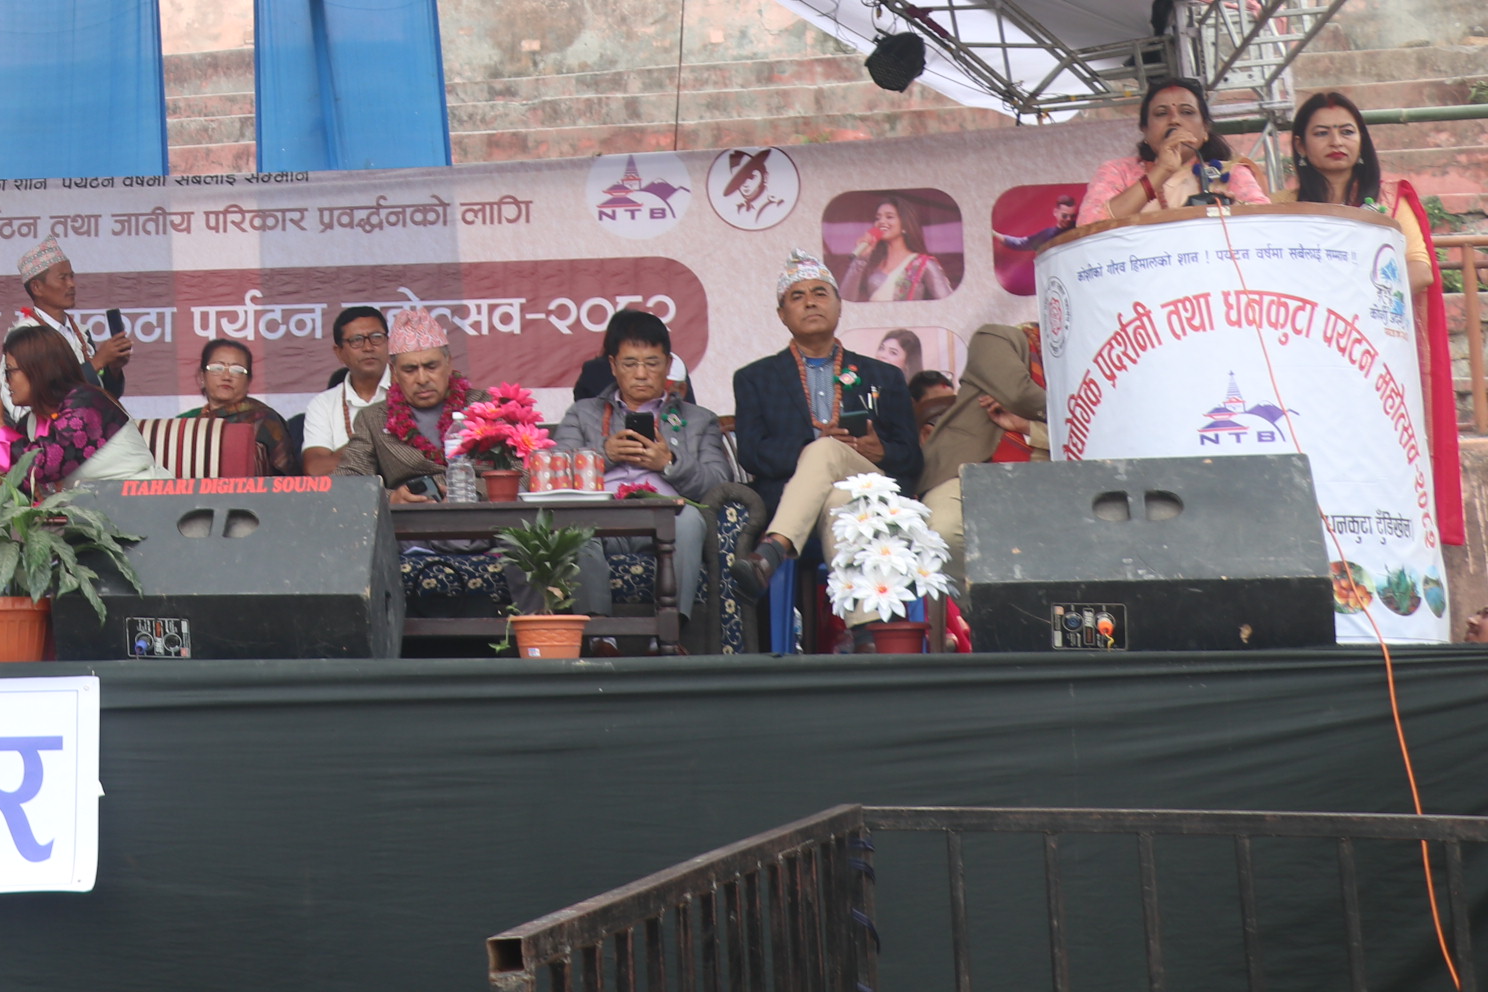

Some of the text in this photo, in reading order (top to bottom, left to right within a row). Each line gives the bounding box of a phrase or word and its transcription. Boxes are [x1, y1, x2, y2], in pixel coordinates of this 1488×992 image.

[49, 214, 102, 238] तथा
[111, 206, 194, 237] जातीय
[203, 204, 308, 234] परिकार
[459, 194, 533, 225] लागि
[598, 208, 667, 221] NTB
[1177, 251, 1199, 266] शान
[191, 290, 327, 340] पर्यटन
[1160, 292, 1215, 341] तथा
[1221, 290, 1319, 346] धनकुटा
[1322, 308, 1379, 379] पर्यटन
[1200, 430, 1276, 446] NTB
[121, 476, 332, 496] ITAHARI DIGITAL SOUND
